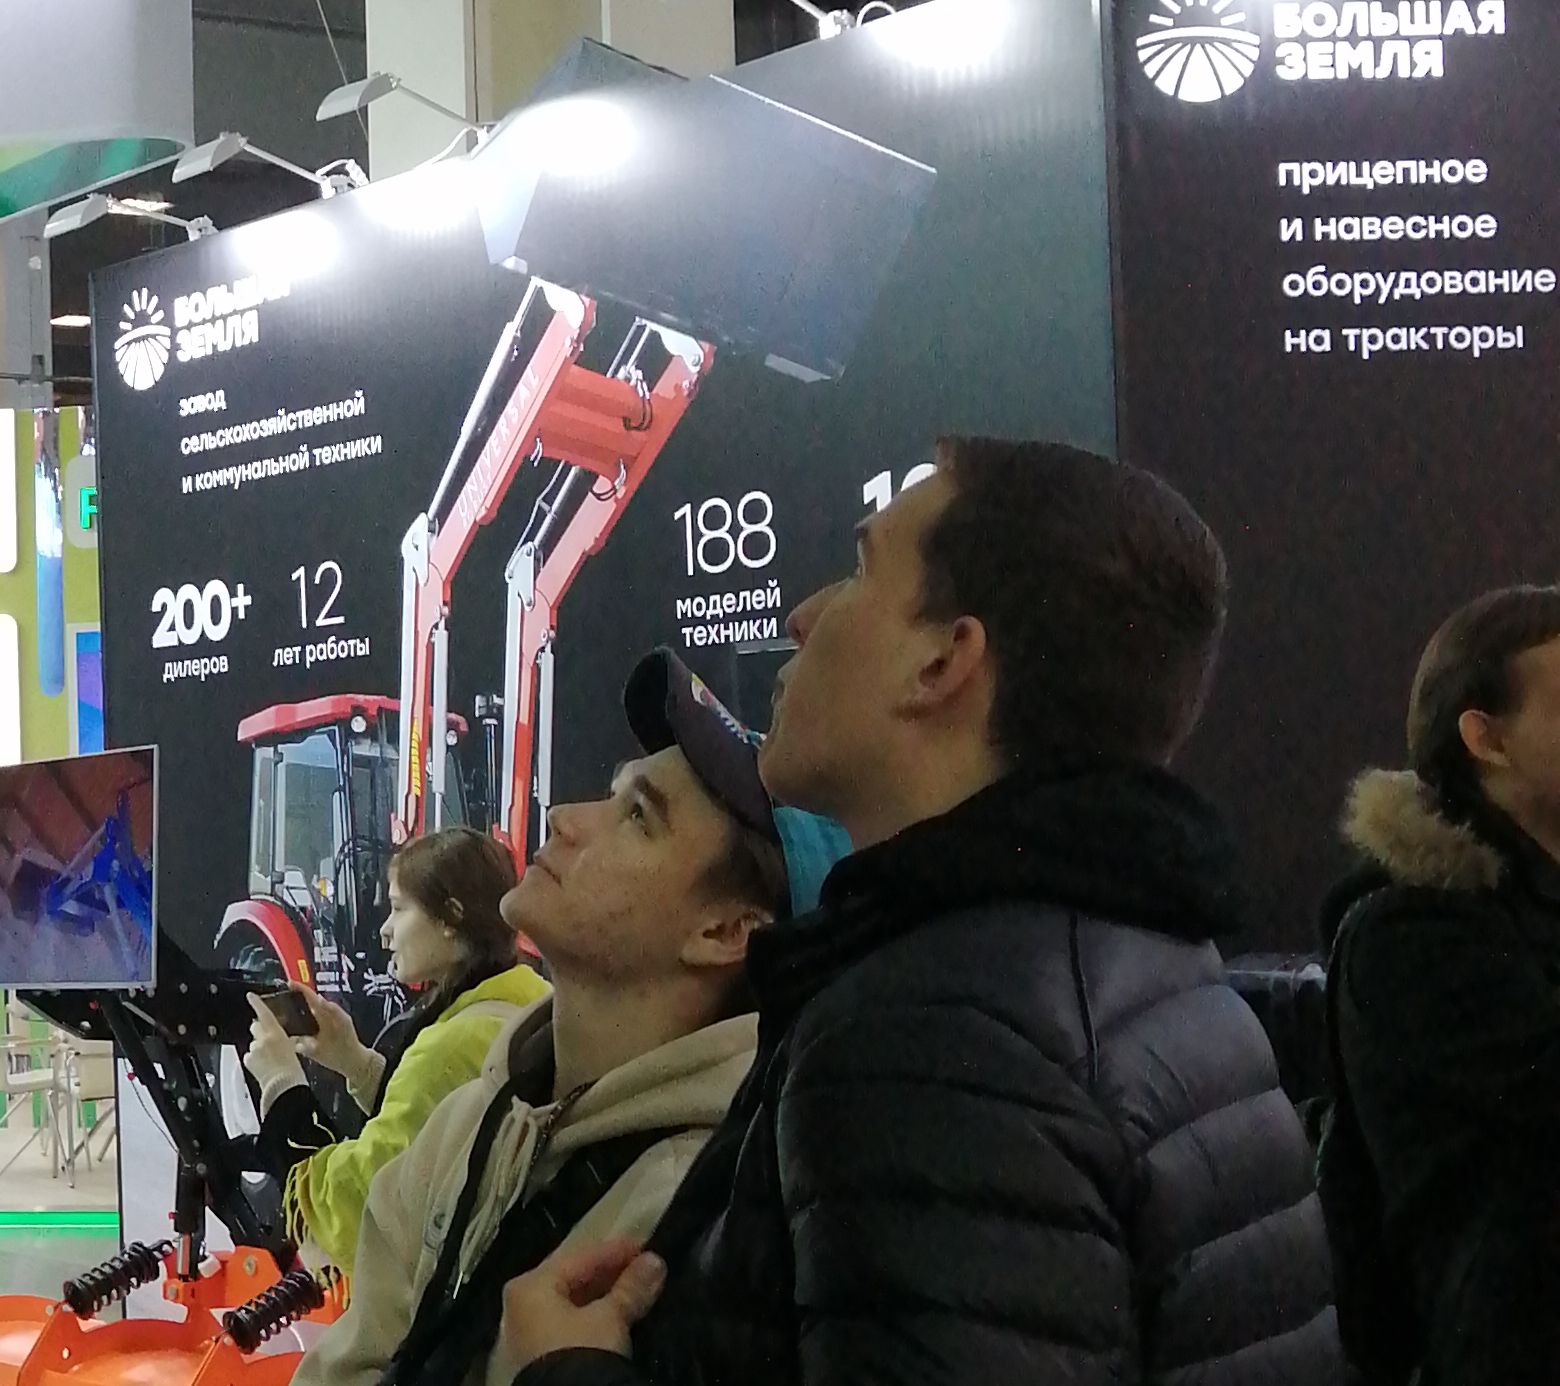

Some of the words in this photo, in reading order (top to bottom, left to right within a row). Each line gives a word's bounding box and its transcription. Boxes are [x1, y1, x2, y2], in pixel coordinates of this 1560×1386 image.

[1273, 0, 1506, 38] БОЛЬШАЯ
[1274, 40, 1444, 81] ЗЕМЛЯ
[1278, 158, 1489, 194] прицепное
[1280, 217, 1303, 242] и
[1314, 213, 1498, 240] навесное
[1282, 265, 1557, 304] оборудование
[176, 310, 260, 362] ЗЕМЛЯ
[1284, 327, 1332, 353] на
[1341, 324, 1525, 360] тракторы
[179, 389, 227, 417] завод
[180, 389, 366, 455] сельскохозяйственной
[456, 365, 540, 521] UNIVERSAL
[182, 475, 192, 494] и
[196, 444, 310, 490] коммунальной
[313, 435, 382, 467] техники
[673, 490, 778, 577] 188
[151, 579, 253, 649] 200+
[291, 560, 346, 629] 12
[676, 578, 782, 620] моделей
[272, 646, 302, 667] лет
[306, 635, 371, 669] работы
[681, 616, 779, 649] техники
[162, 655, 229, 683] дилеров
